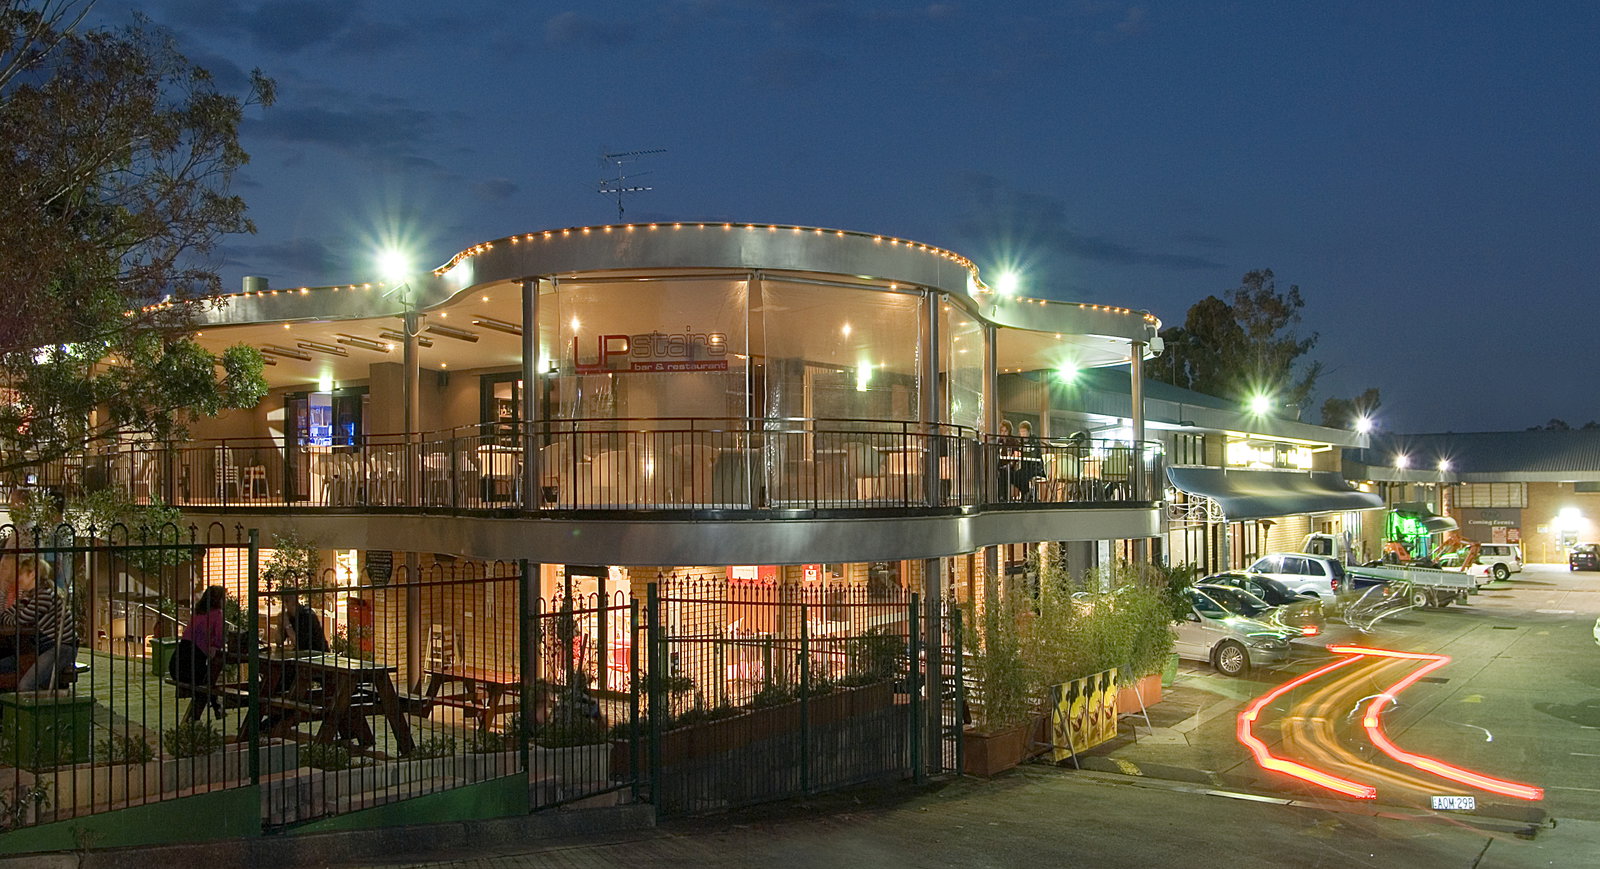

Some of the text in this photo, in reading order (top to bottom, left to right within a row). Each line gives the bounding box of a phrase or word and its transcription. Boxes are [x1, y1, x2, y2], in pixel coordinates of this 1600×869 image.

[574, 325, 728, 369] UPstairs
[655, 363, 665, 371] &
[667, 363, 727, 371] restaurant
